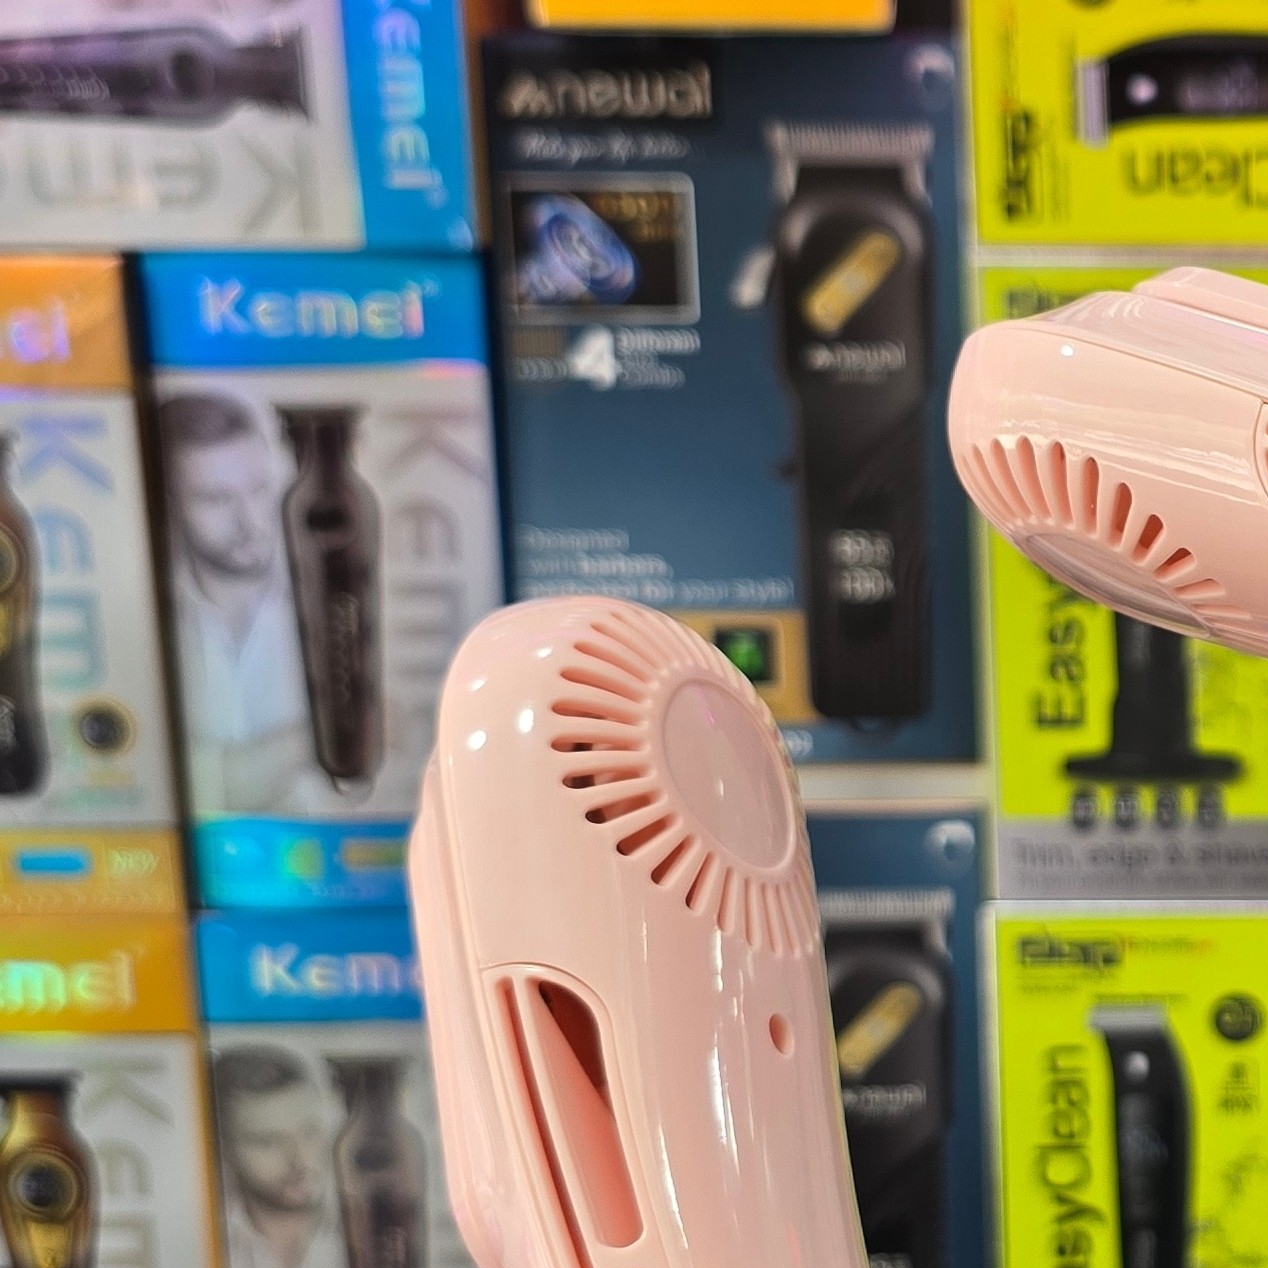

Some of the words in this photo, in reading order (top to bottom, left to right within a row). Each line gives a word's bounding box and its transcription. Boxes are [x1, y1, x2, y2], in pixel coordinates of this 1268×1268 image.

[372, 0, 432, 190] emei
[202, 277, 425, 337] Kemei
[567, 325, 617, 388] 4
[250, 943, 422, 1000] Kem
